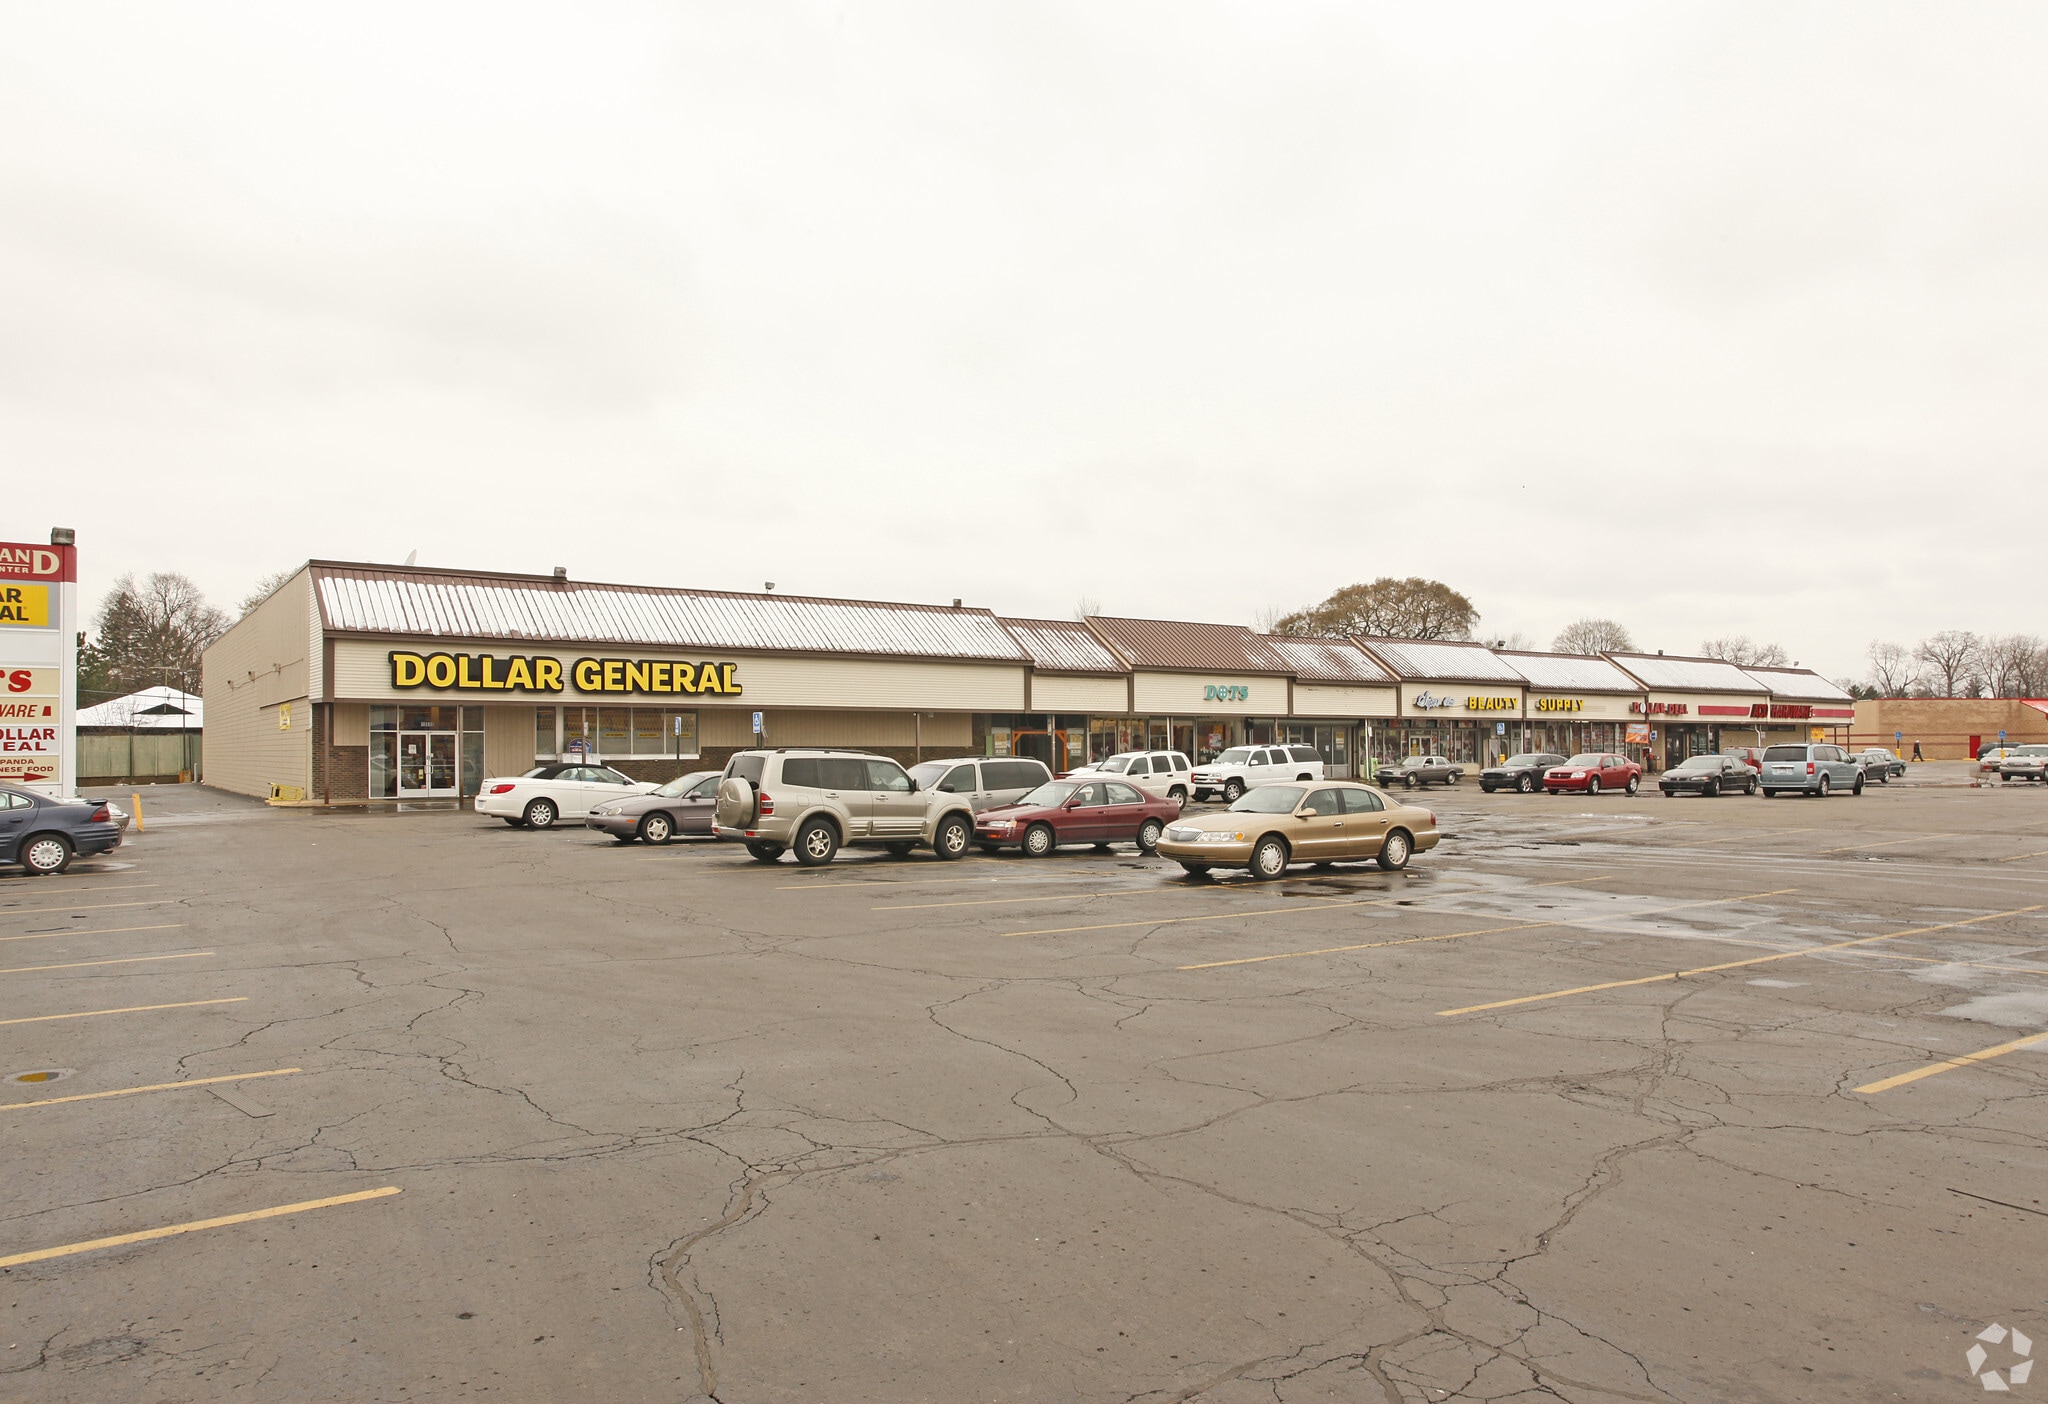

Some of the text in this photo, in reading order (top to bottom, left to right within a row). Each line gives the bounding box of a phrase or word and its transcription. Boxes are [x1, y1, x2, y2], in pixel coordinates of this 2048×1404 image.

[0, 588, 22, 603] R
[0, 669, 32, 692] S
[393, 654, 742, 694] DOLLAR GENERAL
[1203, 685, 1249, 701] DOTS
[1468, 696, 1519, 710] BEAUTY
[1539, 698, 1585, 712] SUPPLY
